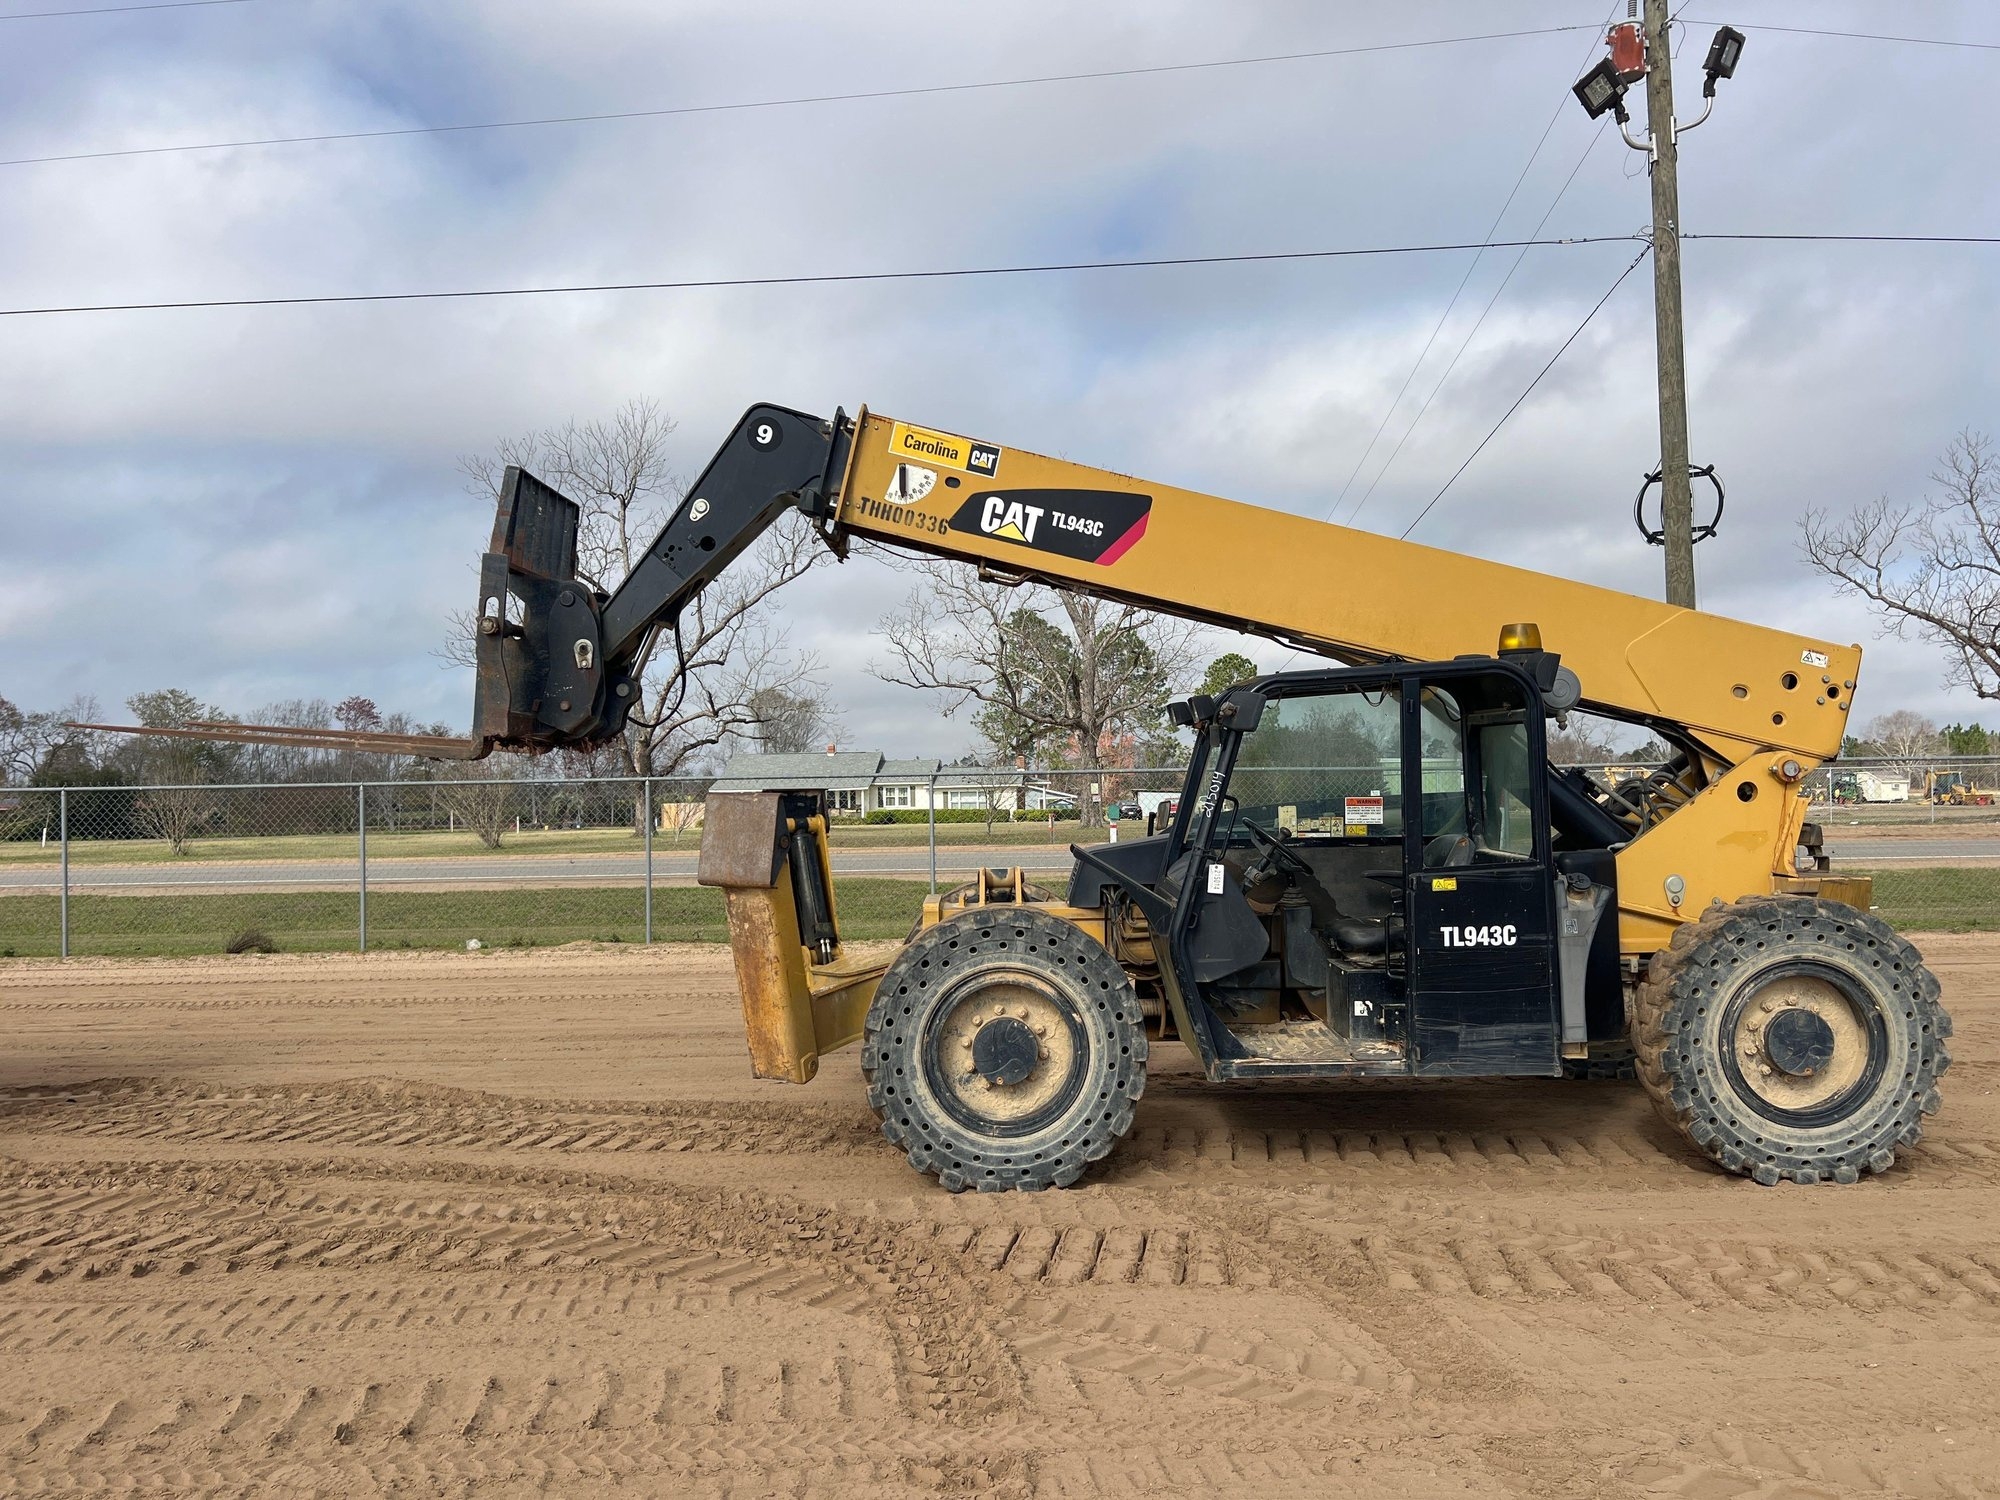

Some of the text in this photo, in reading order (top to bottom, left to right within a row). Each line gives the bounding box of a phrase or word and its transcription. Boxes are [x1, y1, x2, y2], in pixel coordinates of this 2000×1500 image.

[756, 424, 773, 444] 9
[904, 434, 996, 469] Carolina CAT
[859, 497, 950, 535] THH00336
[980, 496, 1045, 543] CAT
[1051, 511, 1104, 537] TL943C
[1440, 924, 1517, 947] TL943C
